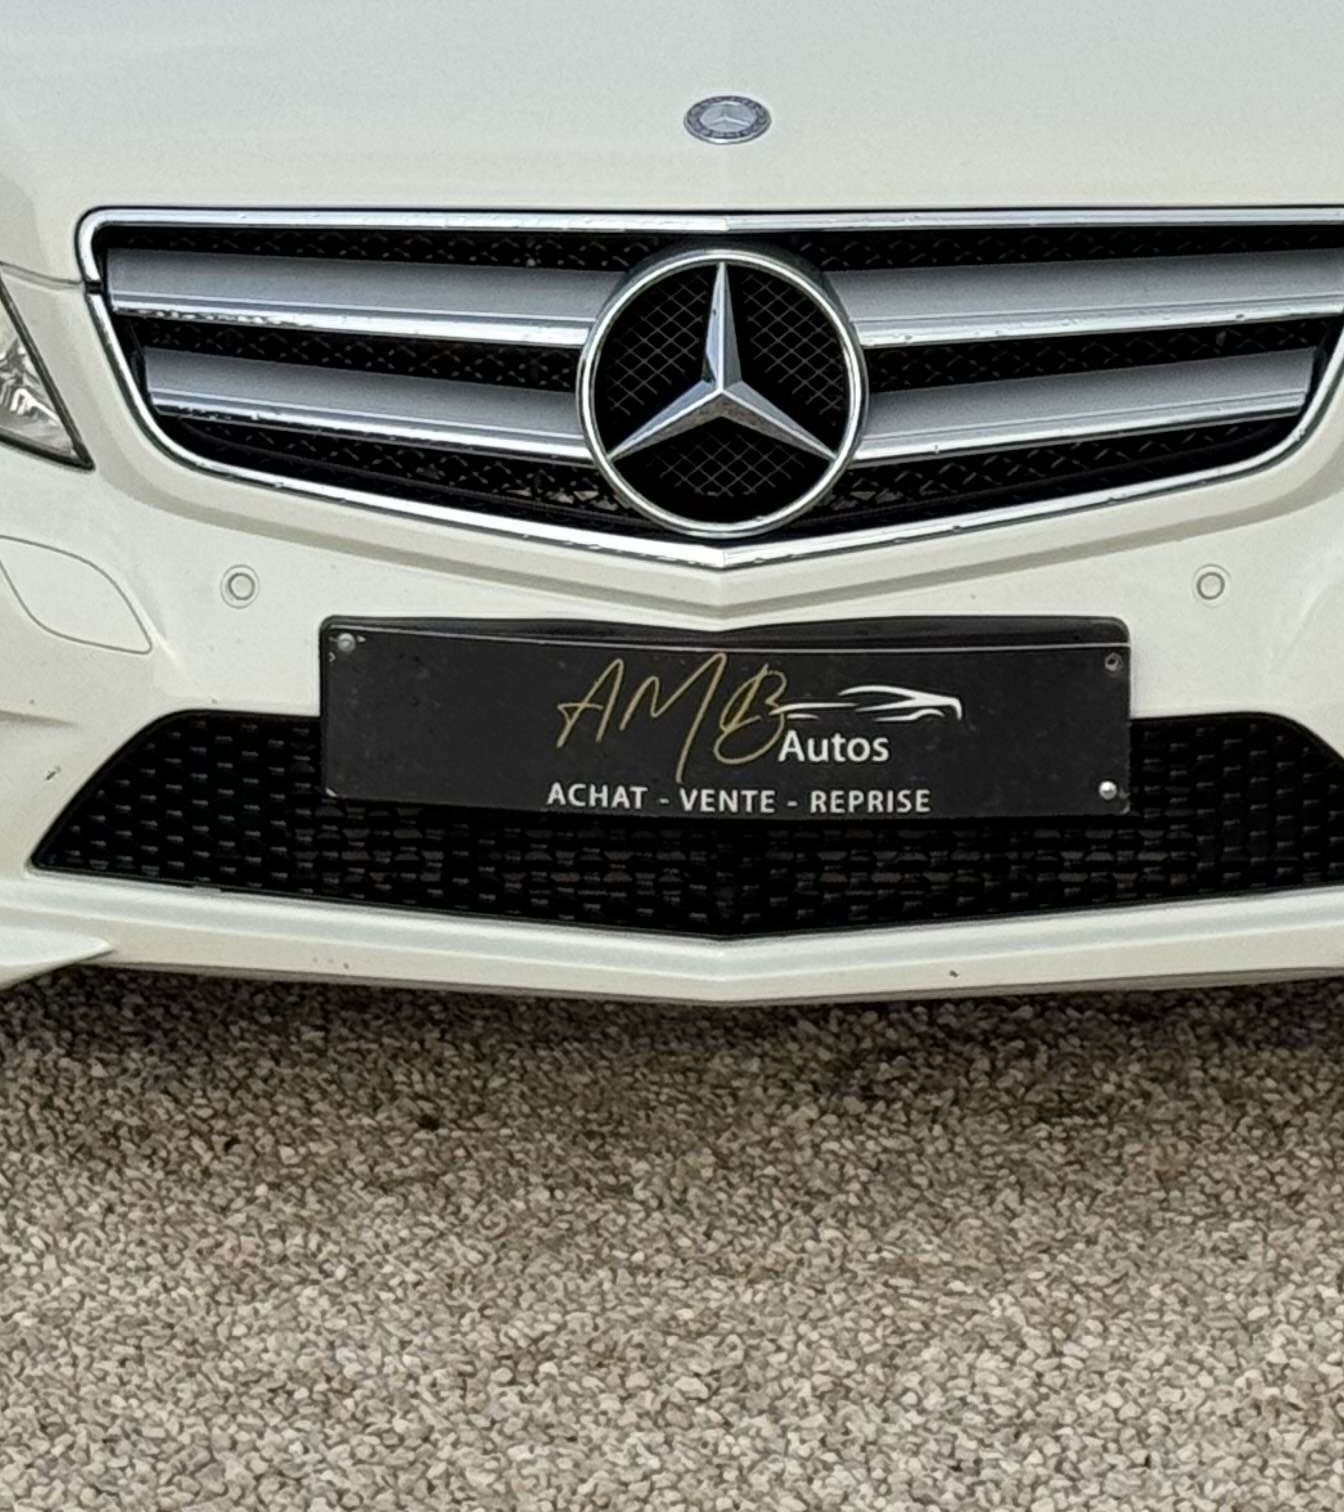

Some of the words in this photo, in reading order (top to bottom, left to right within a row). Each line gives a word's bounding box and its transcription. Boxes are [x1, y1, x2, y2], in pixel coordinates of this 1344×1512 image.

[557, 652, 787, 784] AMB
[777, 729, 890, 763] Autos
[547, 782, 648, 809] ACHAT
[679, 788, 776, 813] VENTE
[809, 789, 931, 814] REPRISE
